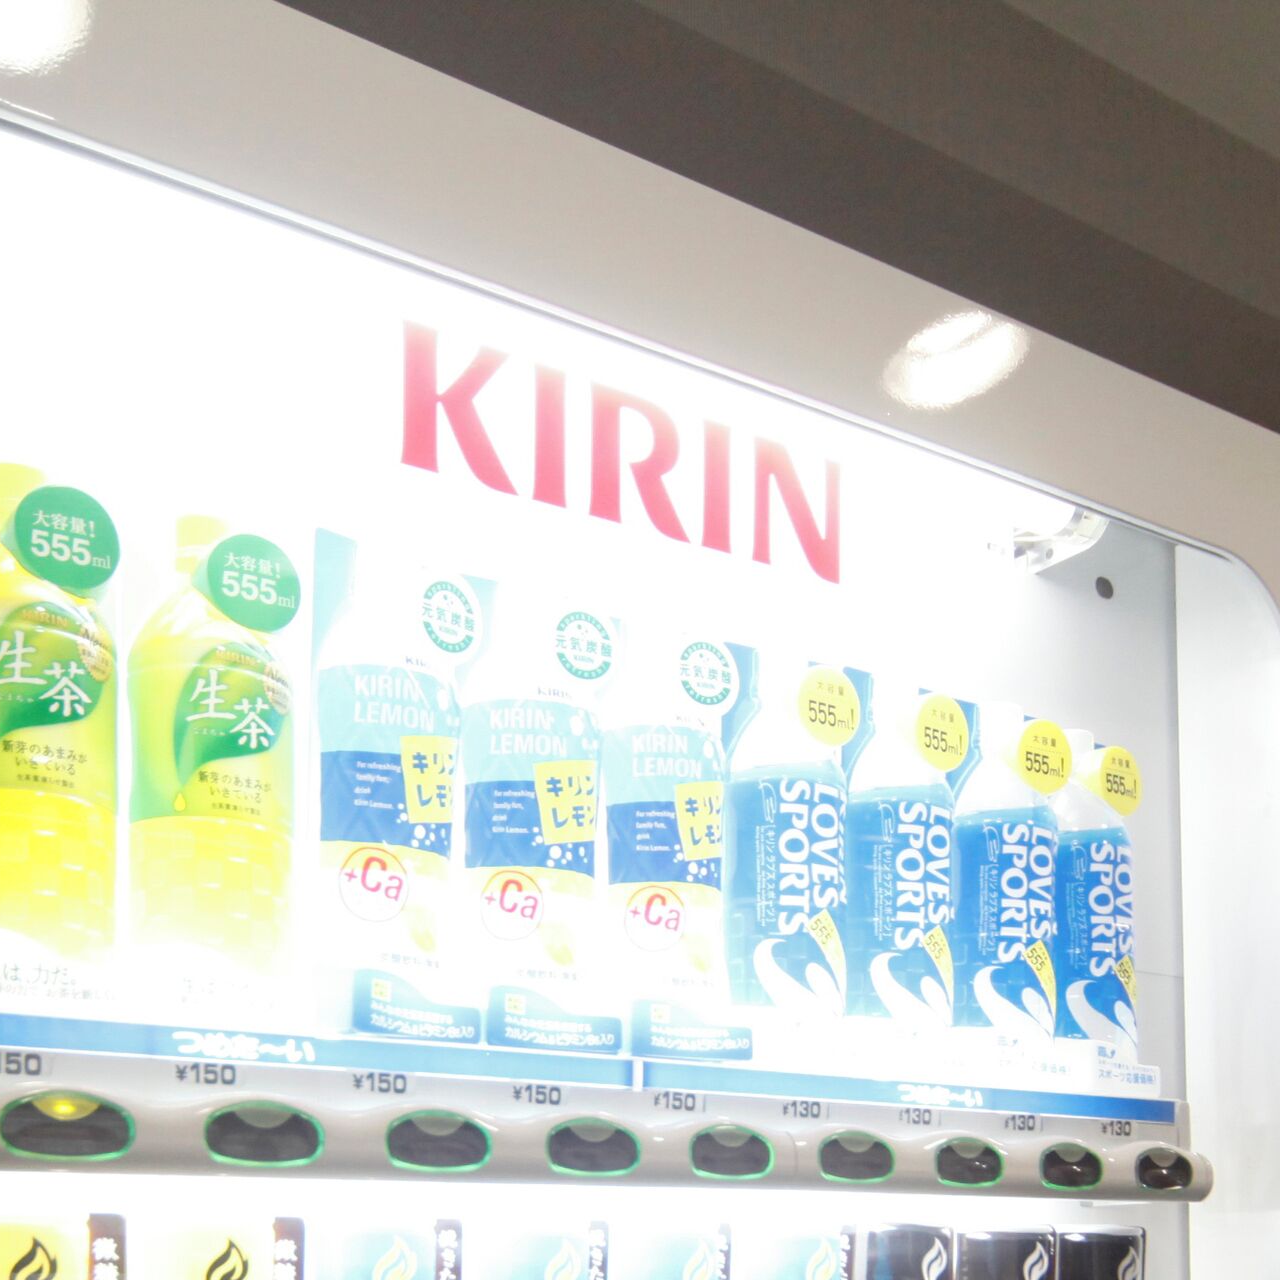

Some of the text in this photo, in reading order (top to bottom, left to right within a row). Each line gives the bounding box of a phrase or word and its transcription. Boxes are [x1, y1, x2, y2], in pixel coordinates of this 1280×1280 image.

[400, 319, 840, 584] KIRIN
[31, 529, 111, 570] 555ml
[222, 570, 295, 609] 555ml
[186, 668, 275, 749] 生茶
[354, 674, 423, 704] KIRIN
[354, 702, 435, 732] LEMON
[490, 707, 550, 731] KIRIN
[490, 733, 567, 758] LEMON
[632, 734, 687, 755] KIRIN
[632, 757, 702, 778] LEMON
[778, 779, 810, 936] SPORTS
[810, 782, 840, 909] LOVES
[926, 804, 951, 925] LOVES
[894, 800, 927, 951] SPORTS
[997, 823, 1028, 963] SPORTS
[1029, 826, 1053, 941] LOVES
[1089, 842, 1118, 977] SPORTS
[1114, 846, 1136, 963] LOVES
[175, 1064, 237, 1086] ¥150
[353, 1073, 407, 1095] ¥150
[513, 1085, 561, 1106] ¥150
[653, 1094, 697, 1112] ¥150
[783, 1100, 821, 1119] ¥130
